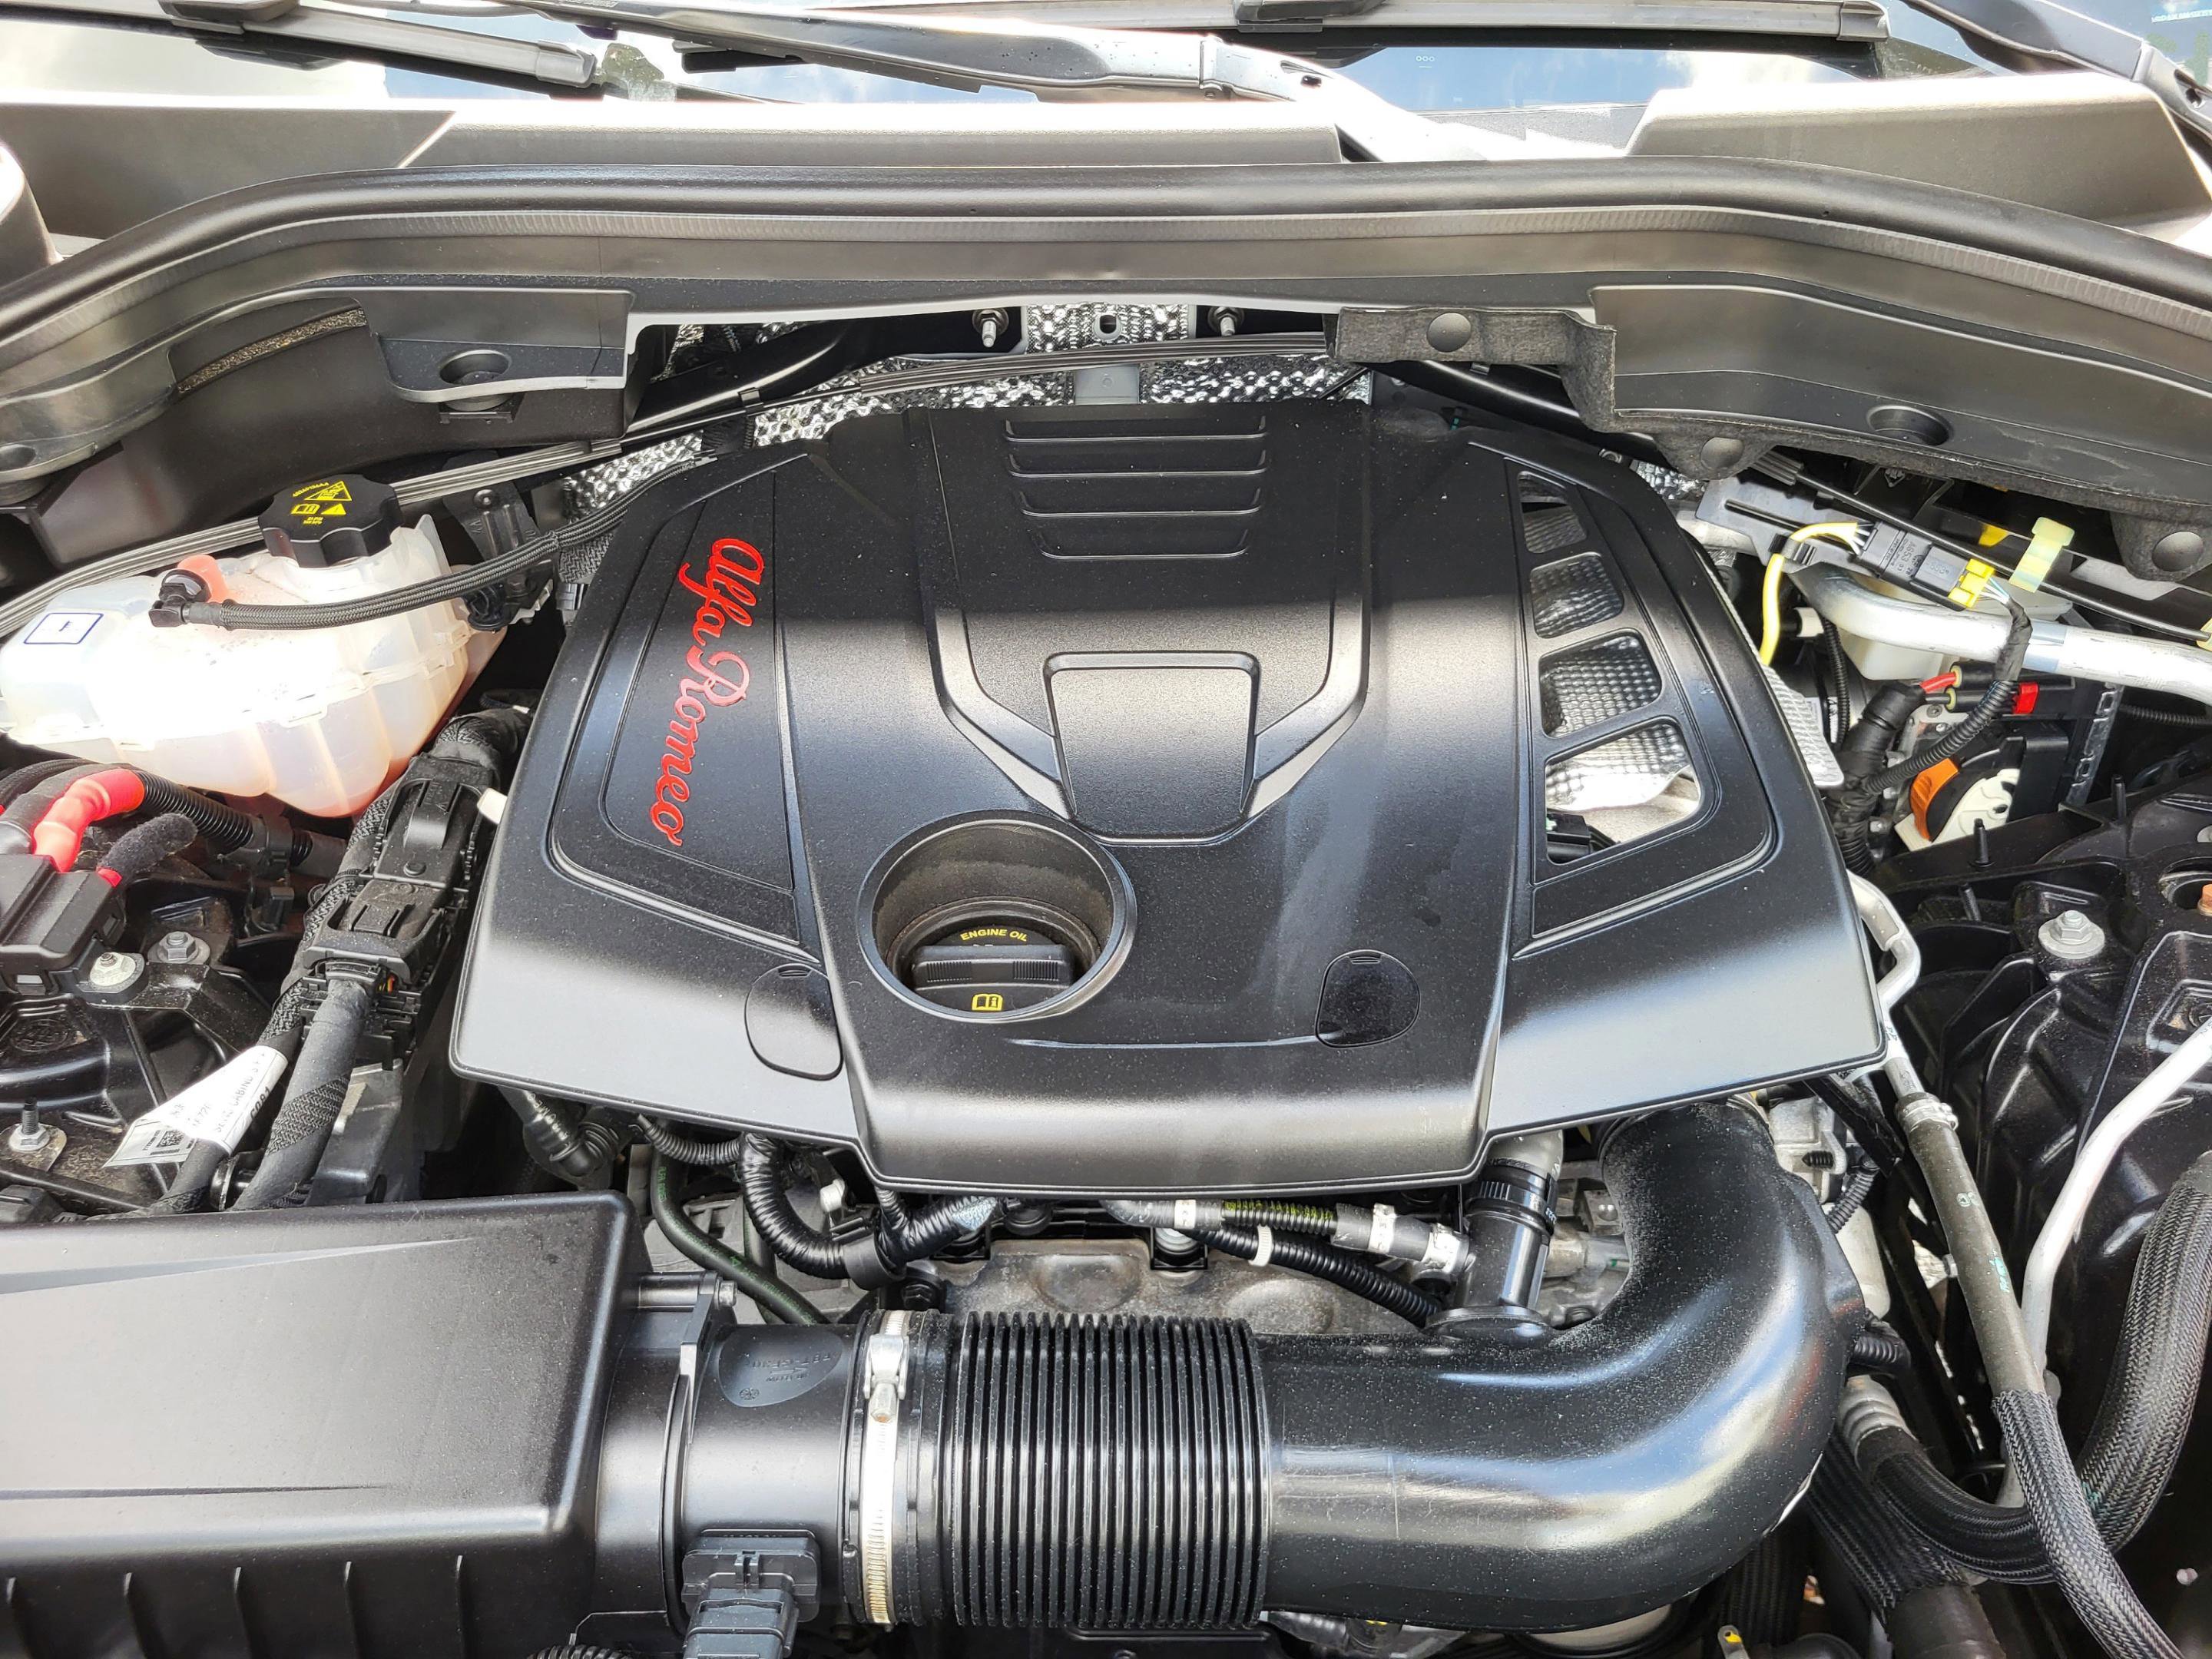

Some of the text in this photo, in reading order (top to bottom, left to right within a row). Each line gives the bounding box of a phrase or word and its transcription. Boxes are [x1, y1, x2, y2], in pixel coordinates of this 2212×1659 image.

[650, 538, 766, 846] Alfa Romeo
[960, 928, 1028, 942] ENGINE OIL
